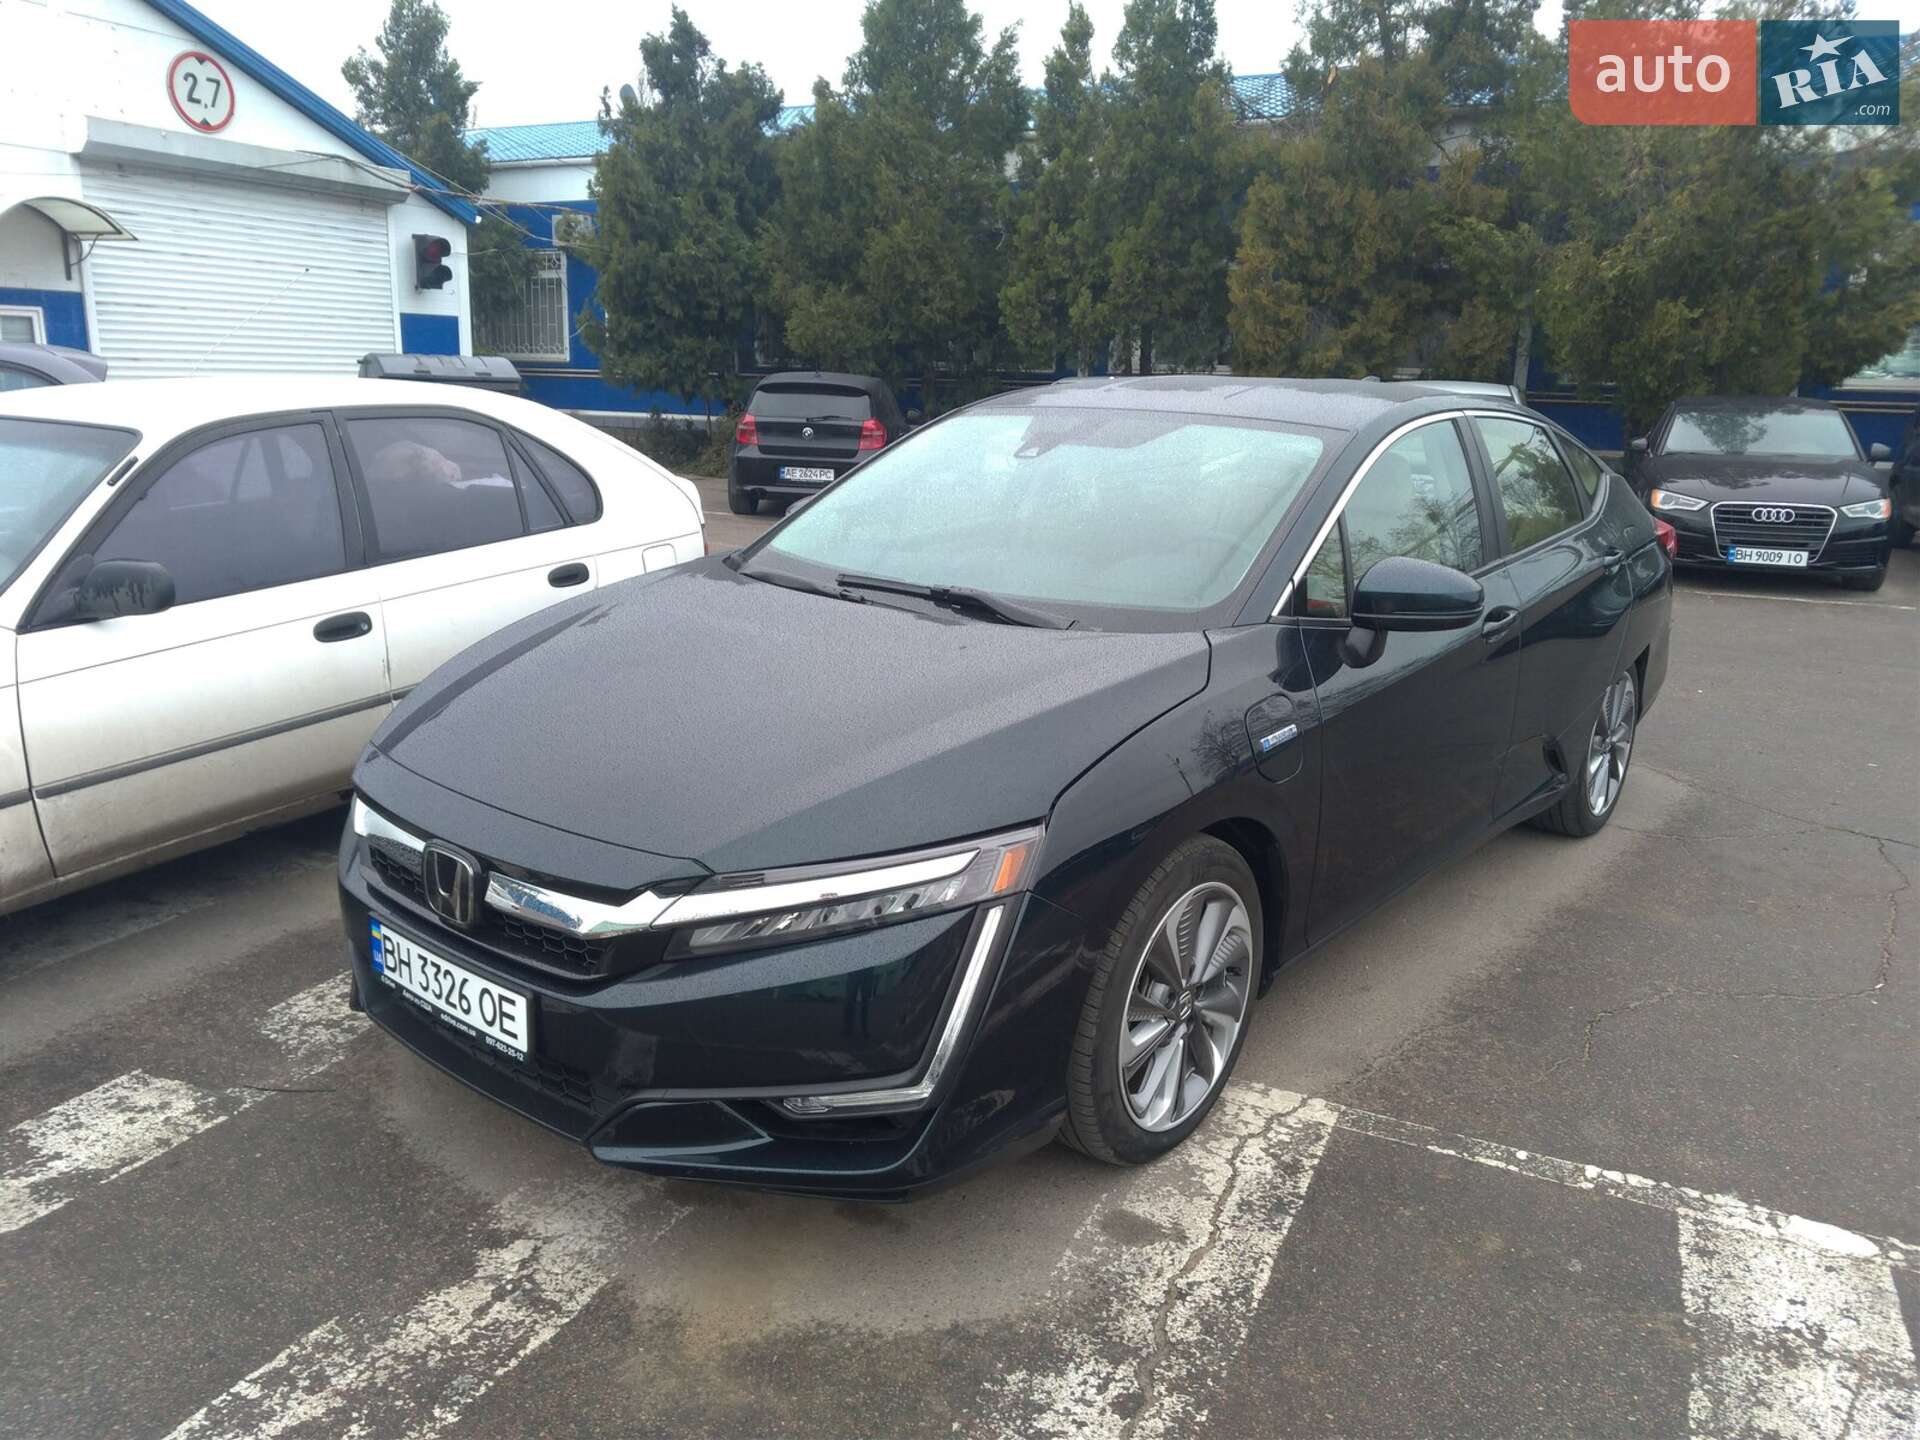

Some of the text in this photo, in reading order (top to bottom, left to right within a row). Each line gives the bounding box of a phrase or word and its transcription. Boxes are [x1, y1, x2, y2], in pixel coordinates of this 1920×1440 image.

[785, 468, 797, 478] AE
[799, 469, 818, 479] 2624
[1735, 549, 1753, 561] BH
[1756, 550, 1783, 563] 9009
[383, 933, 519, 1041] BH 3326 OE
